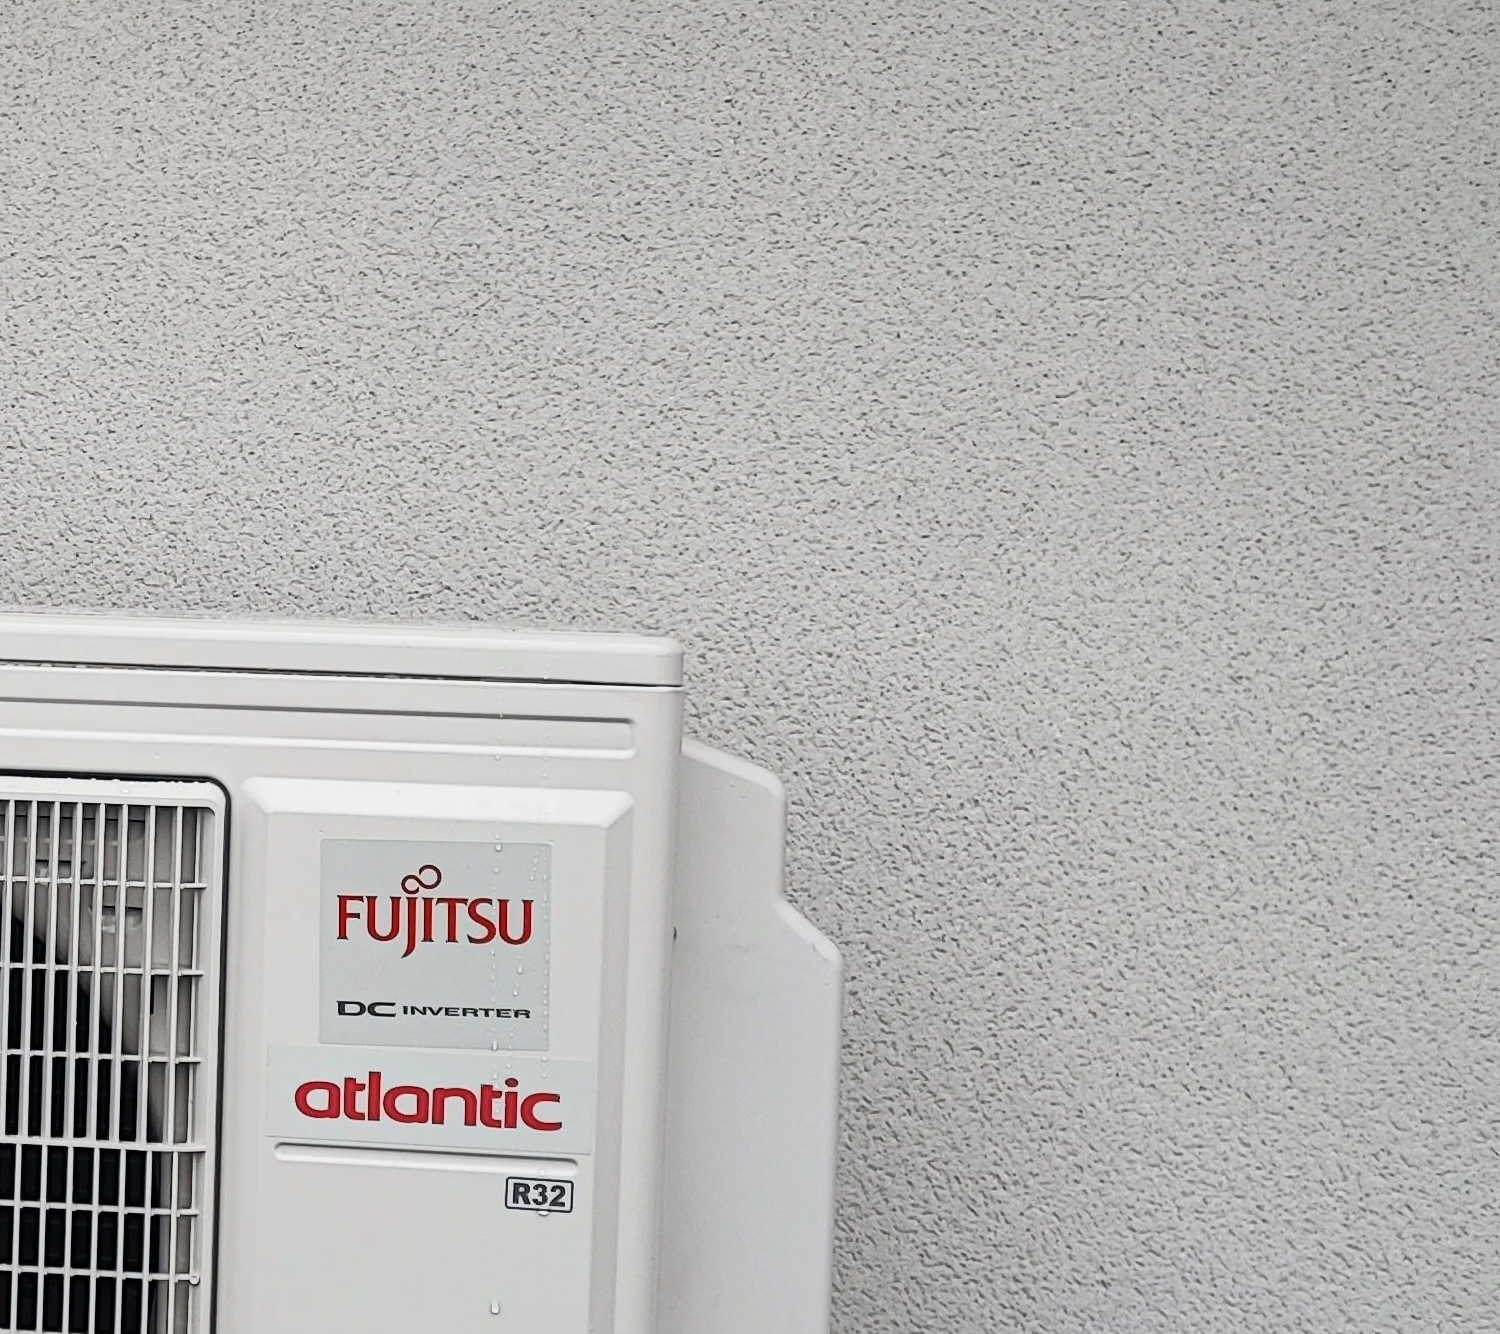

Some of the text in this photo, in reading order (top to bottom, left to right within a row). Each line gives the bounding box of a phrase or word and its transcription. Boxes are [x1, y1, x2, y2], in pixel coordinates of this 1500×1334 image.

[336, 864, 534, 958] FUJITSU
[336, 1000, 531, 1018] DC INVERTER
[294, 1071, 563, 1131] atlantic
[511, 1181, 567, 1209] R32
